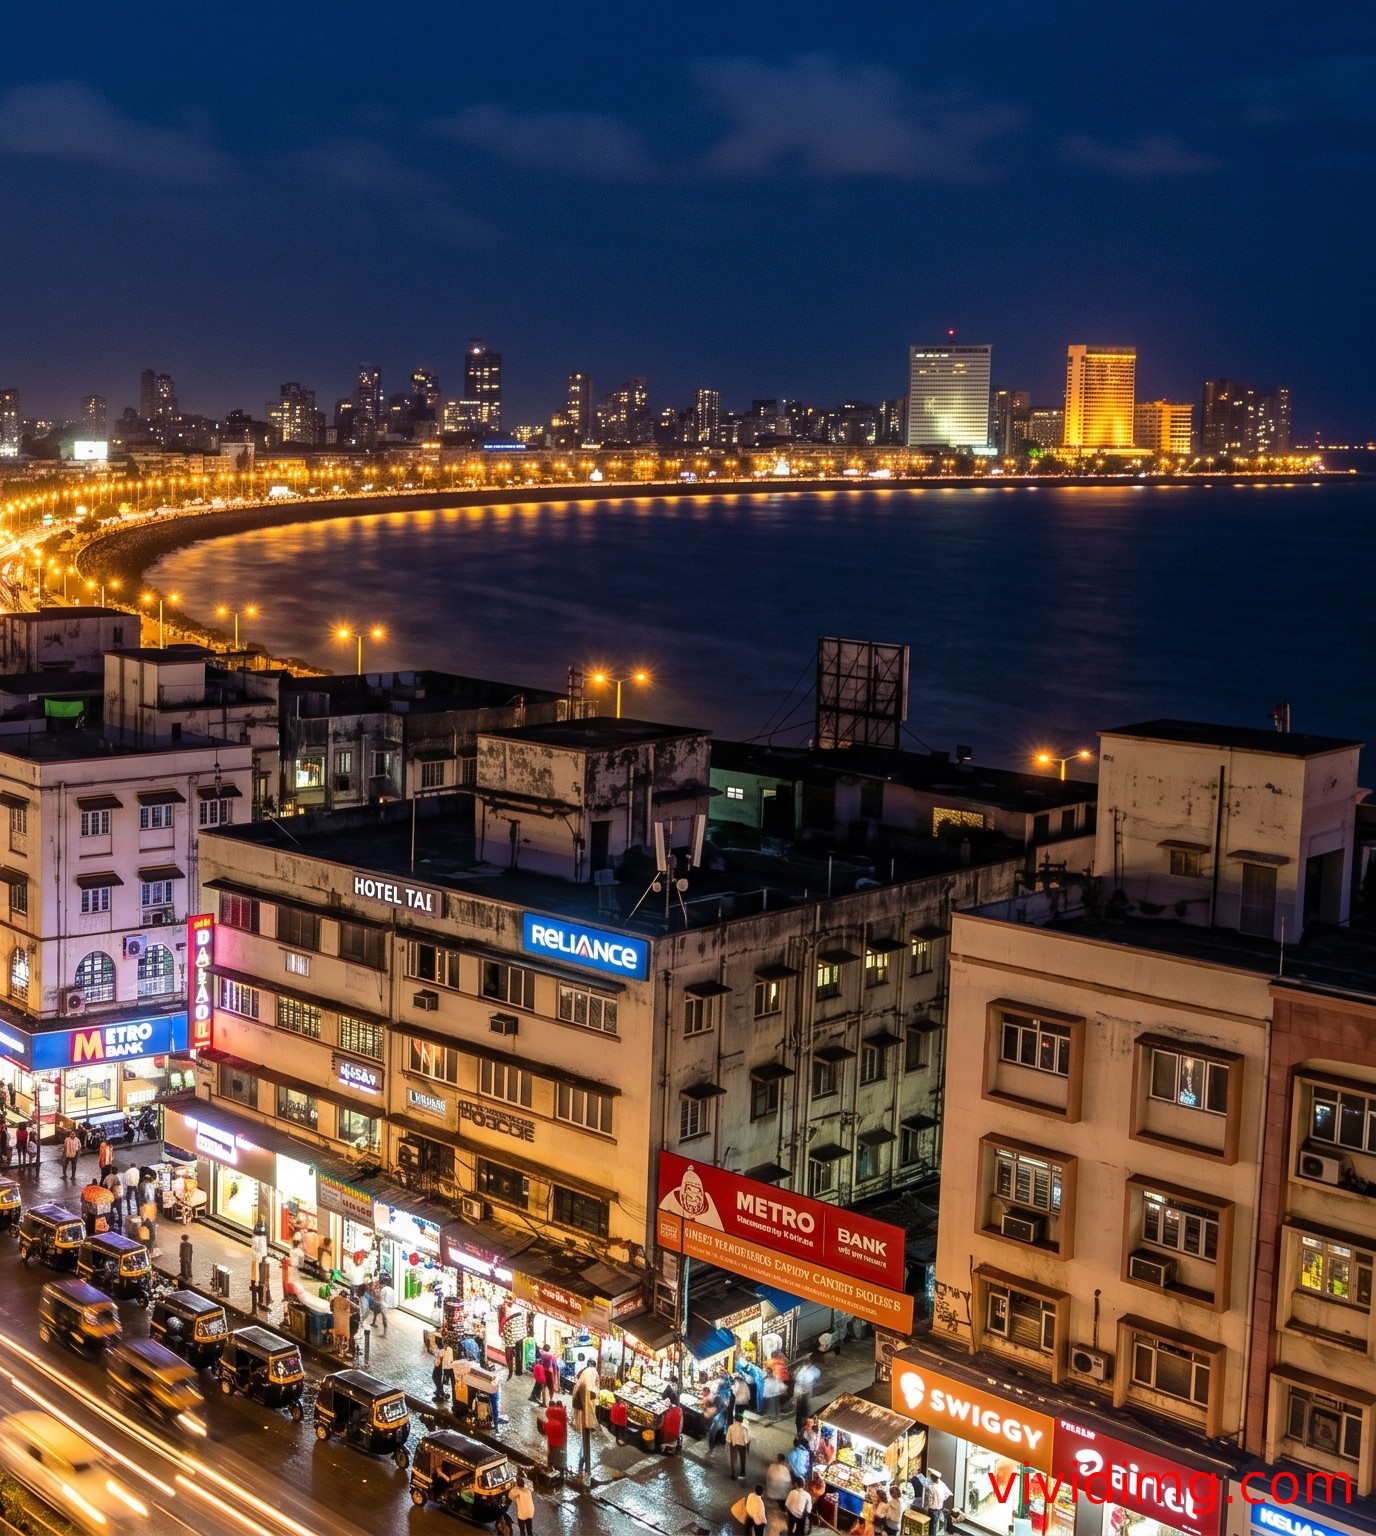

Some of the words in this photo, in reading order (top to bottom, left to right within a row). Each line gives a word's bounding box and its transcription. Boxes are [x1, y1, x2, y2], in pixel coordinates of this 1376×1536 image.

[354, 877, 402, 904] HOTEL
[73, 1023, 153, 1062] METRO
[106, 1042, 143, 1058] BANK
[737, 1191, 815, 1233] METRO
[838, 1228, 888, 1257] BANK
[929, 1389, 1043, 1449] SWIGGY
